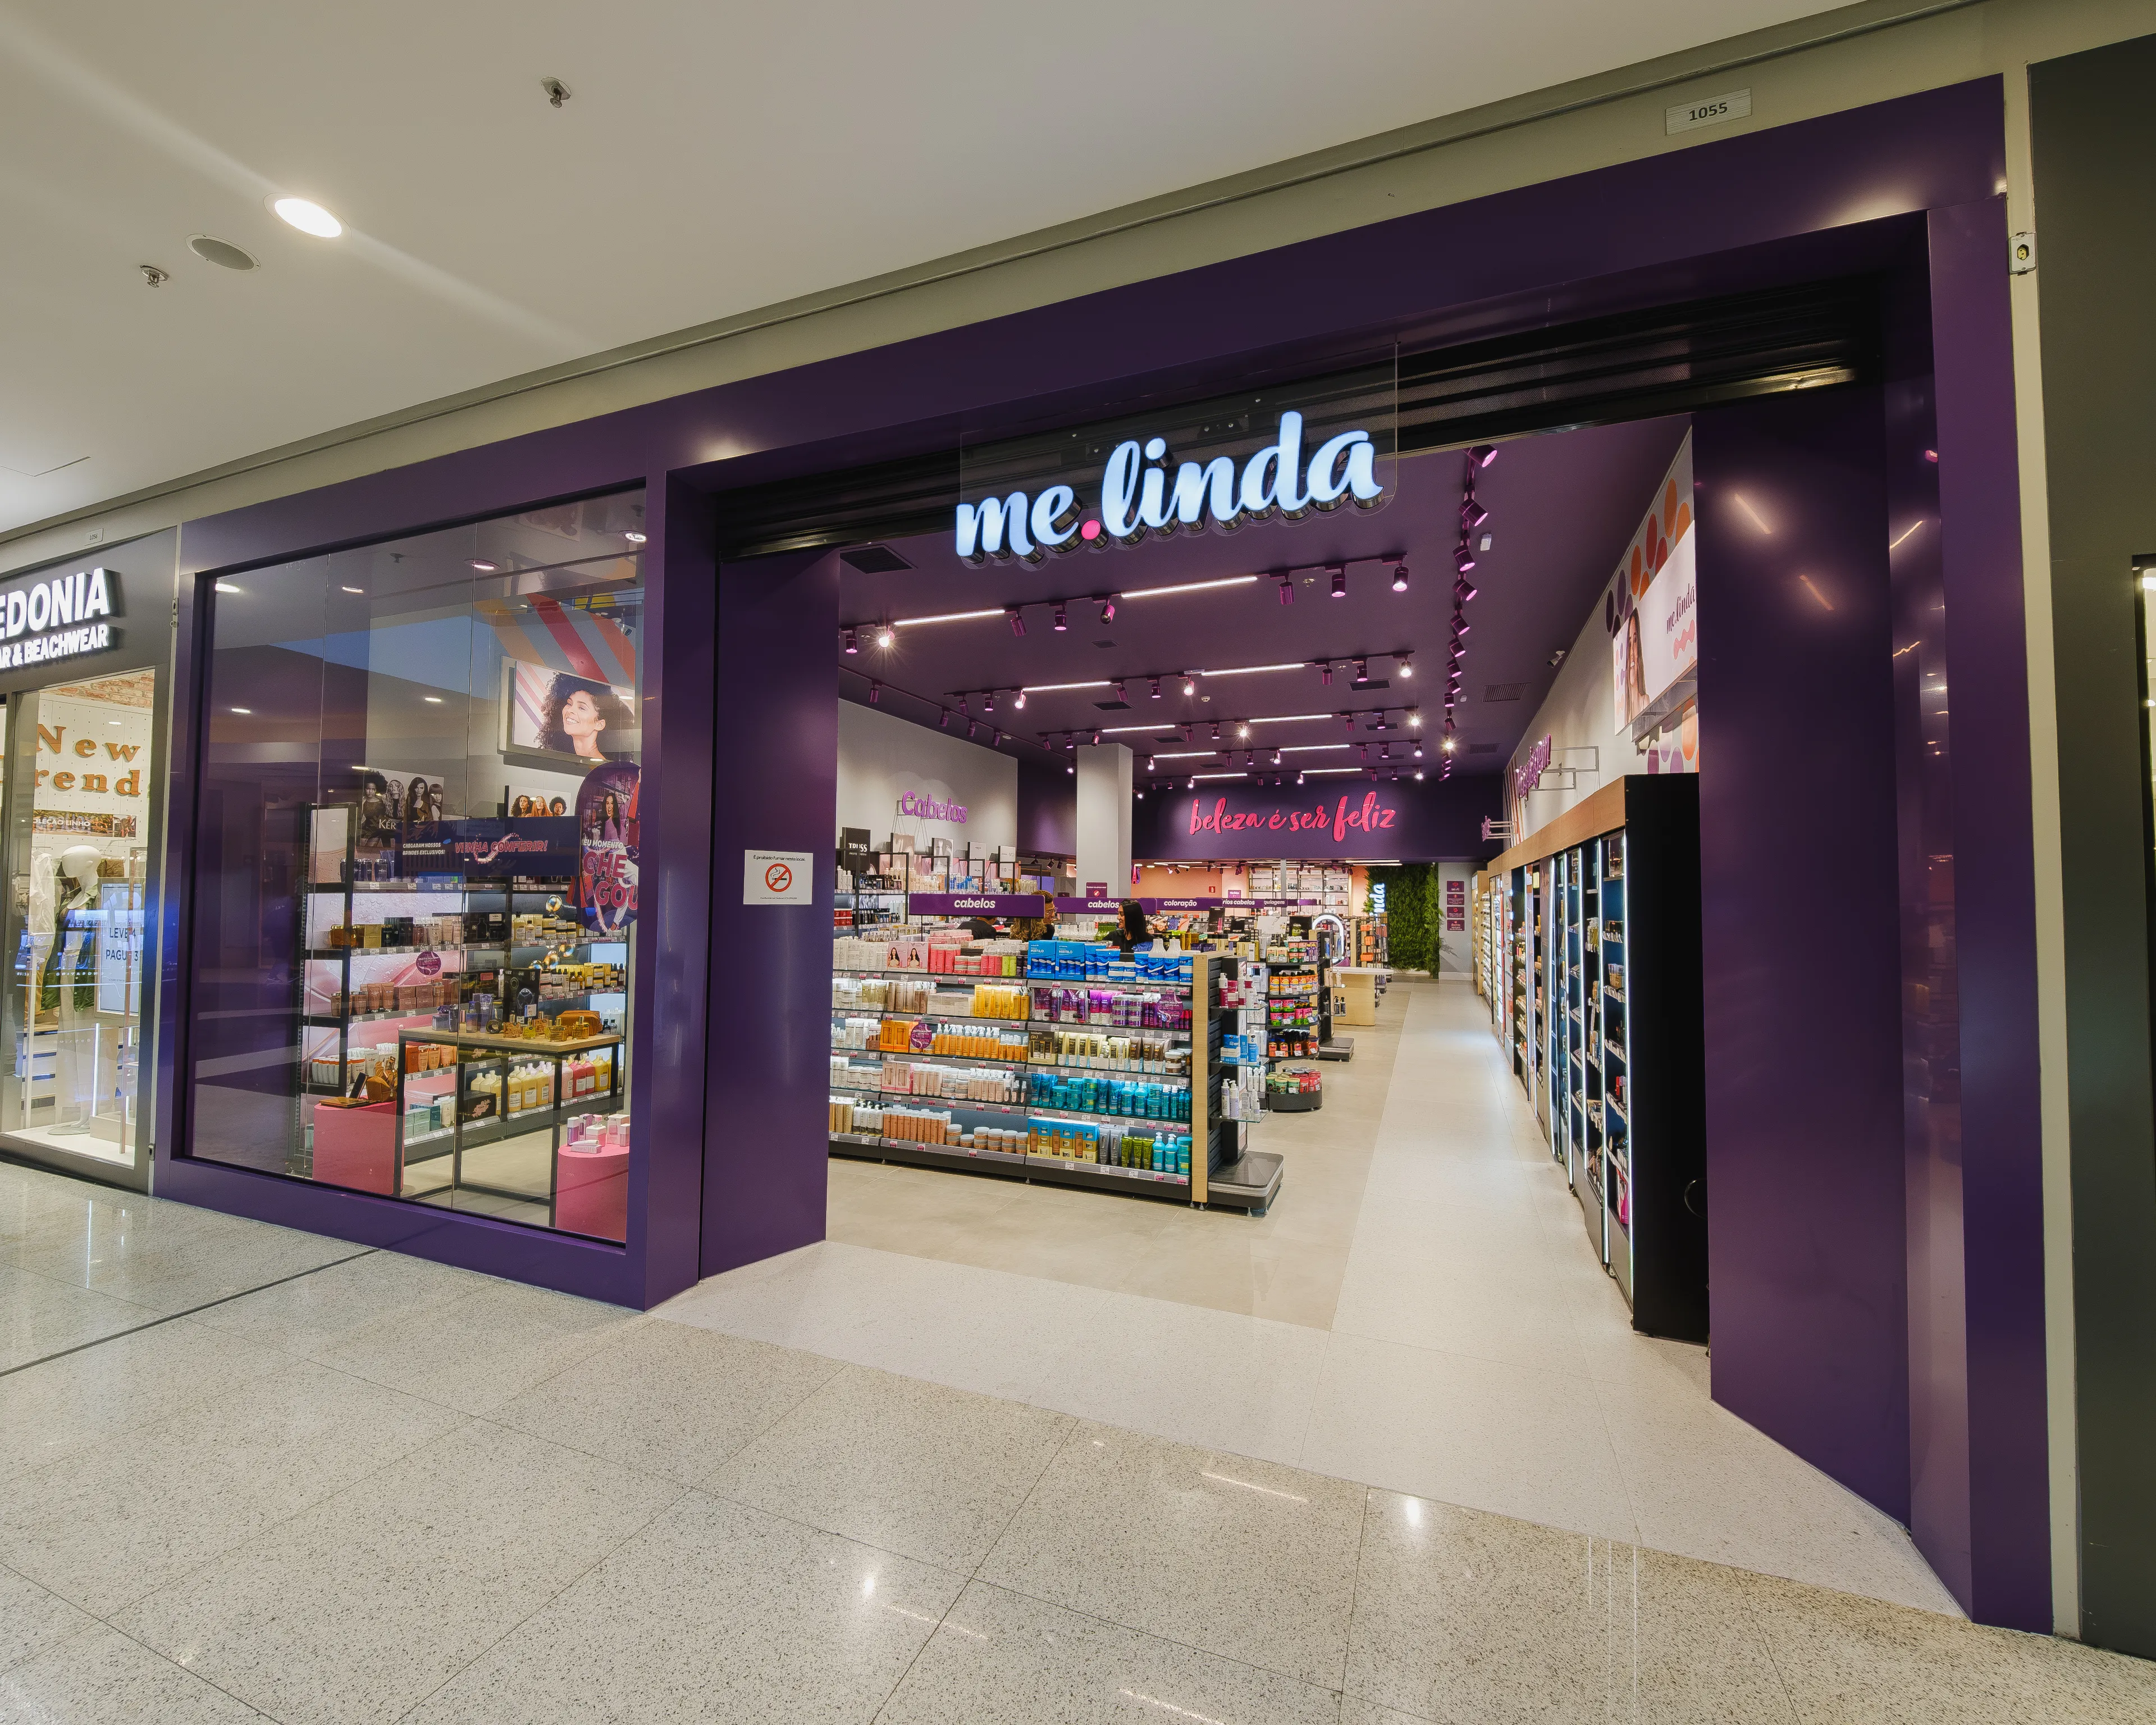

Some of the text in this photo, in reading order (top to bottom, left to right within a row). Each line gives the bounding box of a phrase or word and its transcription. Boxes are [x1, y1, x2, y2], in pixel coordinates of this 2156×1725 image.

[1689, 102, 1728, 121] 1055
[956, 410, 1384, 558] me.linda
[1666, 583, 1695, 635] me.linda
[24, 624, 108, 663] BEACHWEAR
[36, 723, 141, 762] New
[901, 790, 968, 824] Cabelos
[1189, 797, 1265, 835] beleza
[1289, 805, 1330, 832] ser
[1333, 791, 1396, 842] feliz
[455, 840, 547, 854] VENHA CONFERIR!
[592, 839, 624, 849] MOMENTO
[583, 851, 628, 878] CHE
[954, 897, 996, 909] cabelos
[1088, 900, 1120, 909] cabelos
[1163, 900, 1197, 908] coloração
[106, 949, 138, 961] PAGU 3
